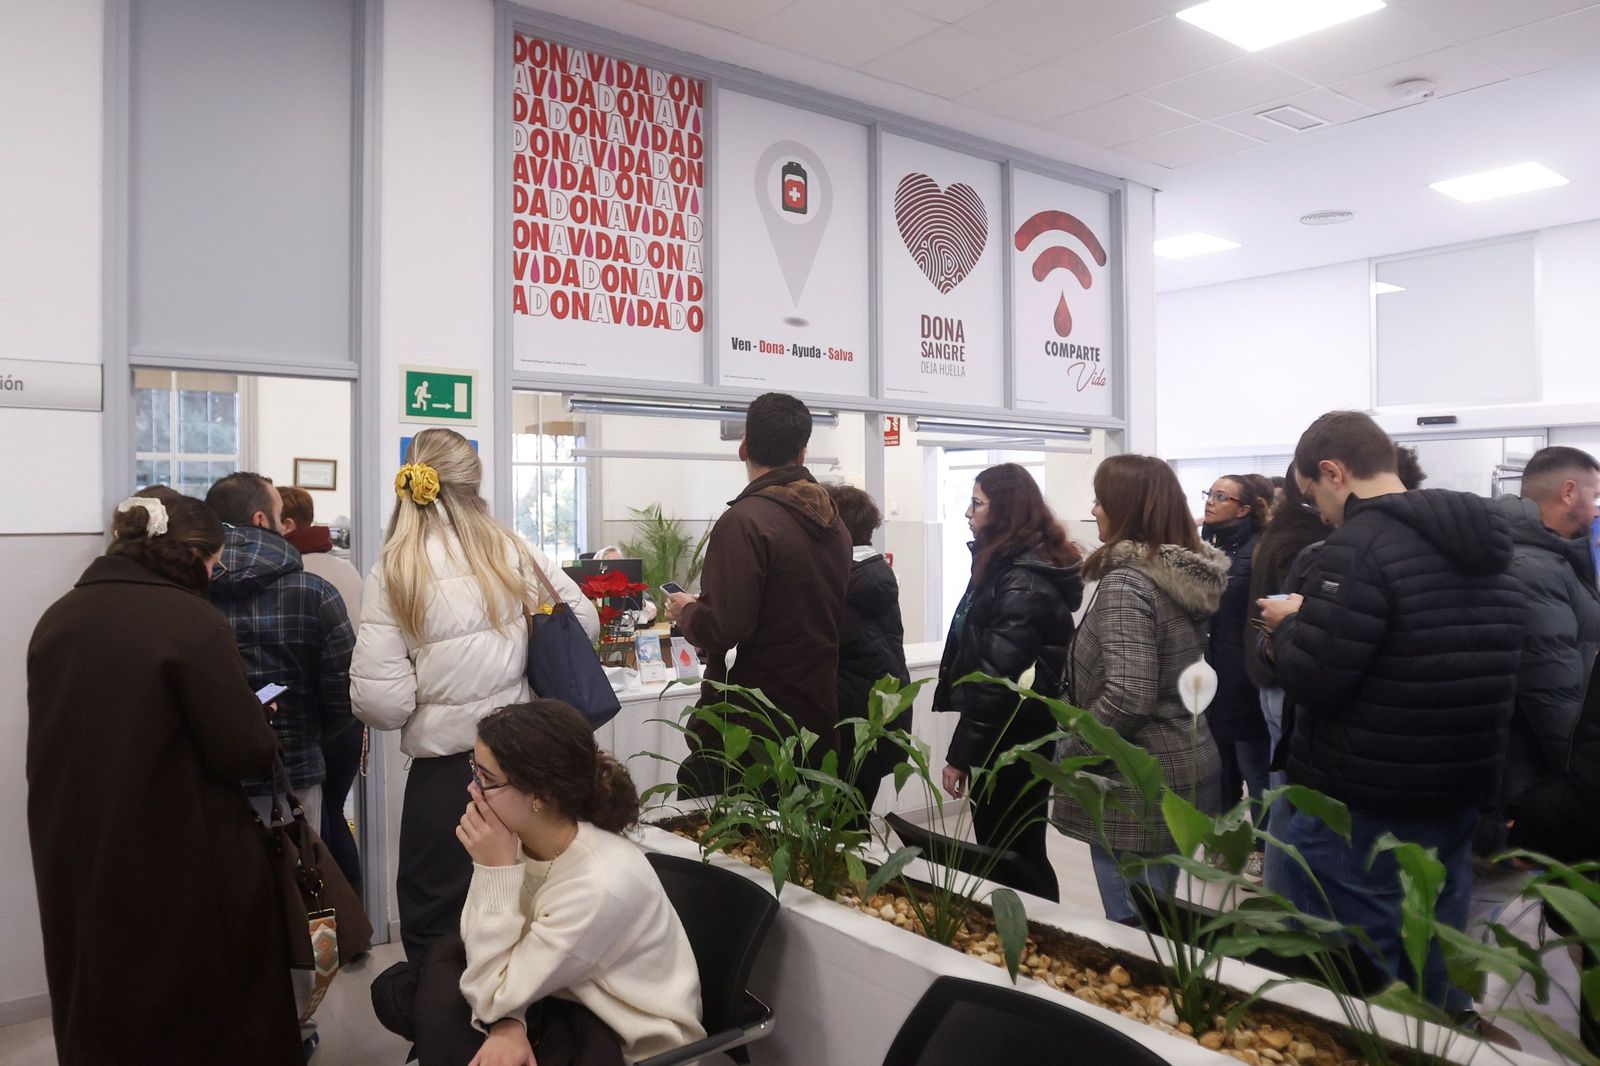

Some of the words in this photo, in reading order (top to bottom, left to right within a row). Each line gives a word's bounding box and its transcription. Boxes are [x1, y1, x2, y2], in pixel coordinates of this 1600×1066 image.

[921, 314, 965, 343] DONA
[731, 337, 751, 351] Ven
[759, 340, 784, 355] Dona
[792, 344, 821, 358] Ayuda
[828, 347, 853, 362] Salva
[921, 341, 965, 362] SANGRE
[1045, 340, 1100, 362] COMPARTE
[921, 361, 938, 374] DEJA
[939, 363, 966, 377] HUELLA
[1067, 361, 1106, 392] Vida
